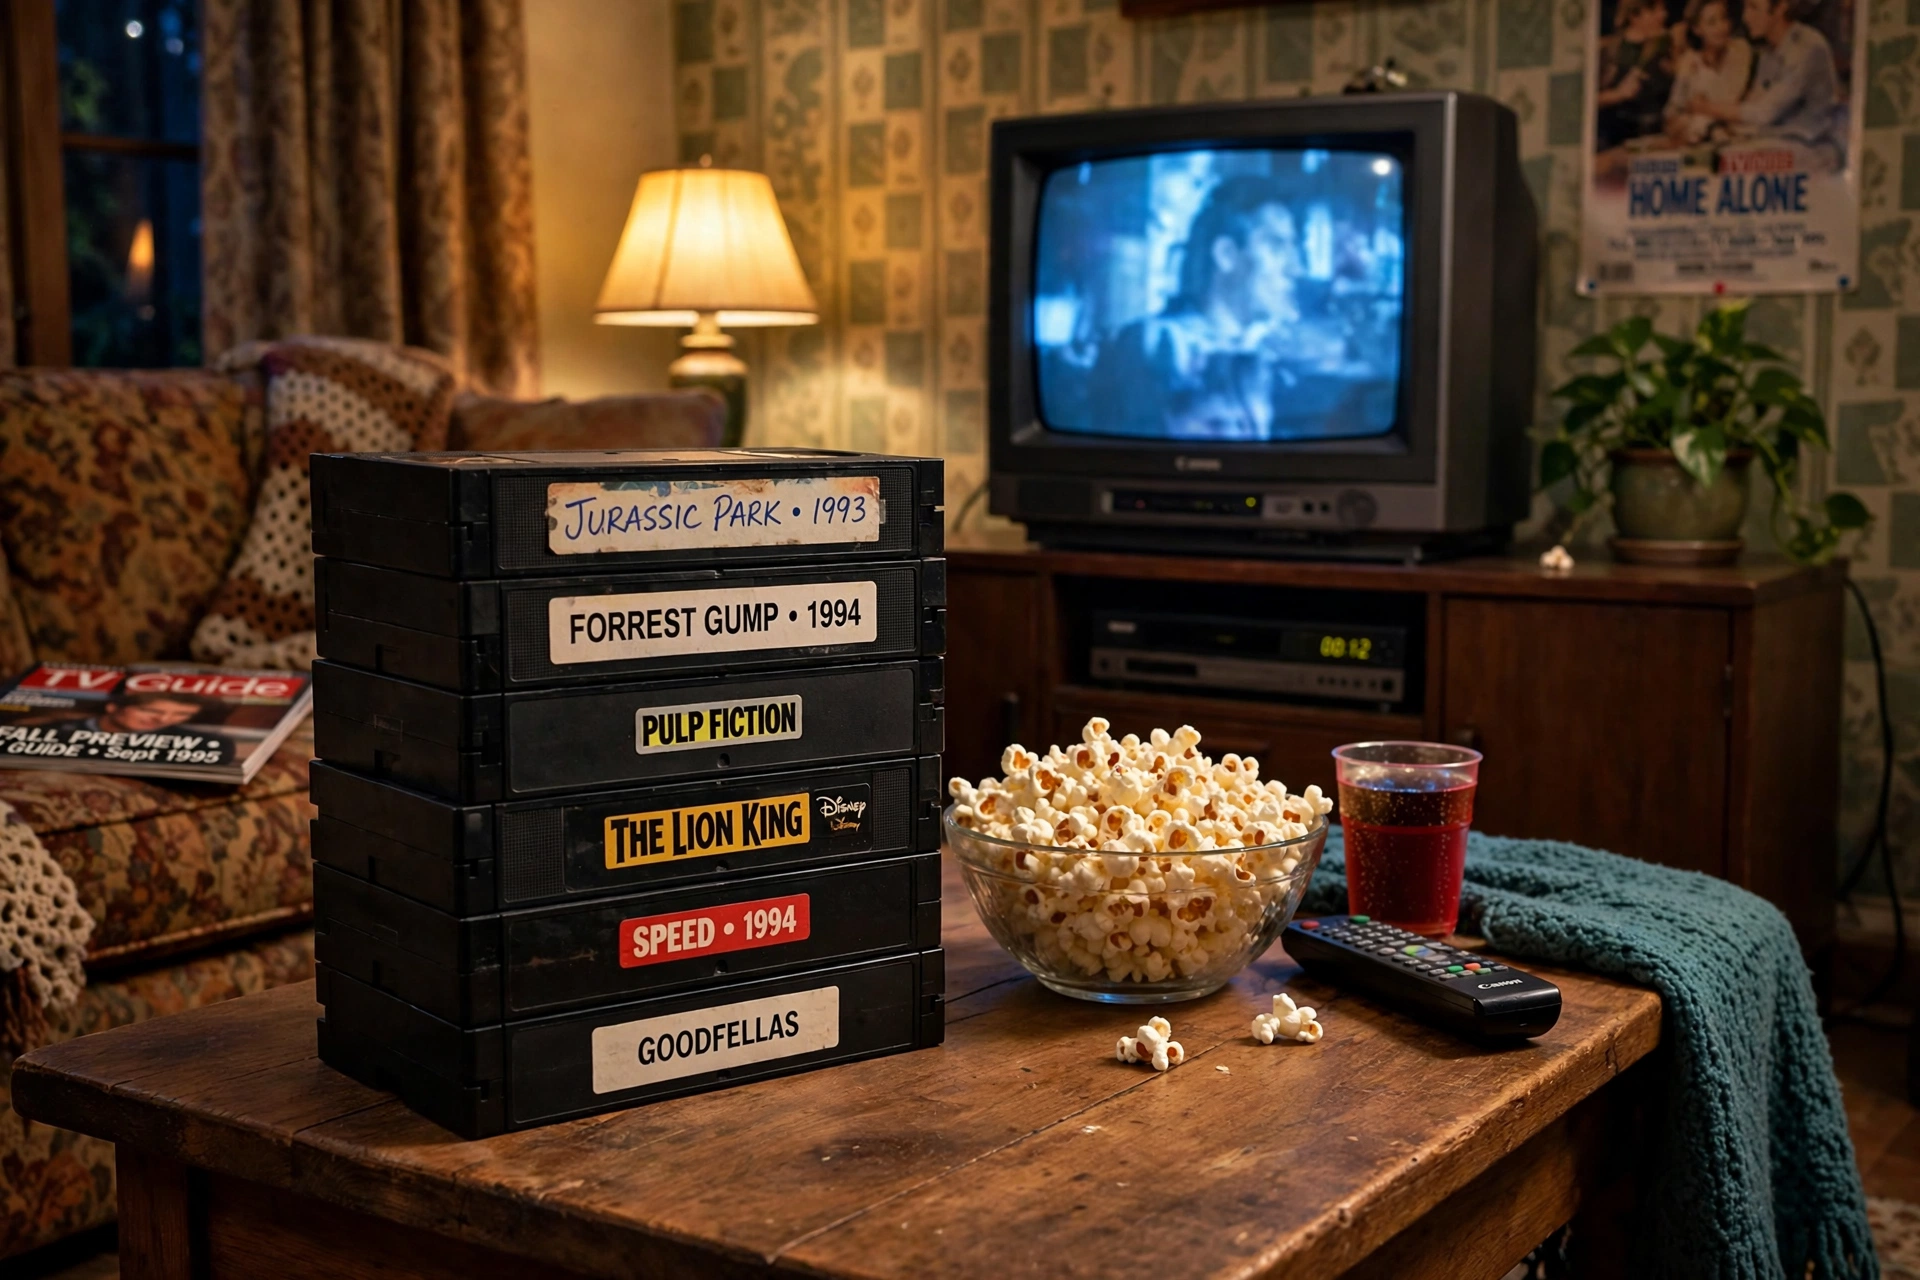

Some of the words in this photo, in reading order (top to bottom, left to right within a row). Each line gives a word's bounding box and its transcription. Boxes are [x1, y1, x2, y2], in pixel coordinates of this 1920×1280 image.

[1629, 177, 1708, 217] HOME
[1716, 172, 1808, 214] ALONE
[565, 497, 702, 540] JURASSIC
[714, 494, 781, 531] PARK
[813, 496, 866, 525] 1993
[570, 607, 697, 644] FORREST
[704, 602, 779, 636] GUMP
[807, 598, 861, 629] 1994
[41, 669, 120, 690] TV
[125, 673, 289, 698] Guide
[0, 725, 59, 743] FALL
[68, 729, 203, 750] PREVIEW
[642, 710, 704, 747] PULP
[709, 702, 796, 740] FICTION
[7, 741, 84, 757] GUIDE
[104, 746, 159, 763] Sept
[166, 748, 222, 763] 1995
[610, 818, 665, 864] THE
[672, 809, 733, 856] LION
[741, 801, 802, 847] KING
[633, 917, 715, 958] SPEED
[743, 905, 796, 940] 1994
[638, 1010, 800, 1065] GOODFELLAS
